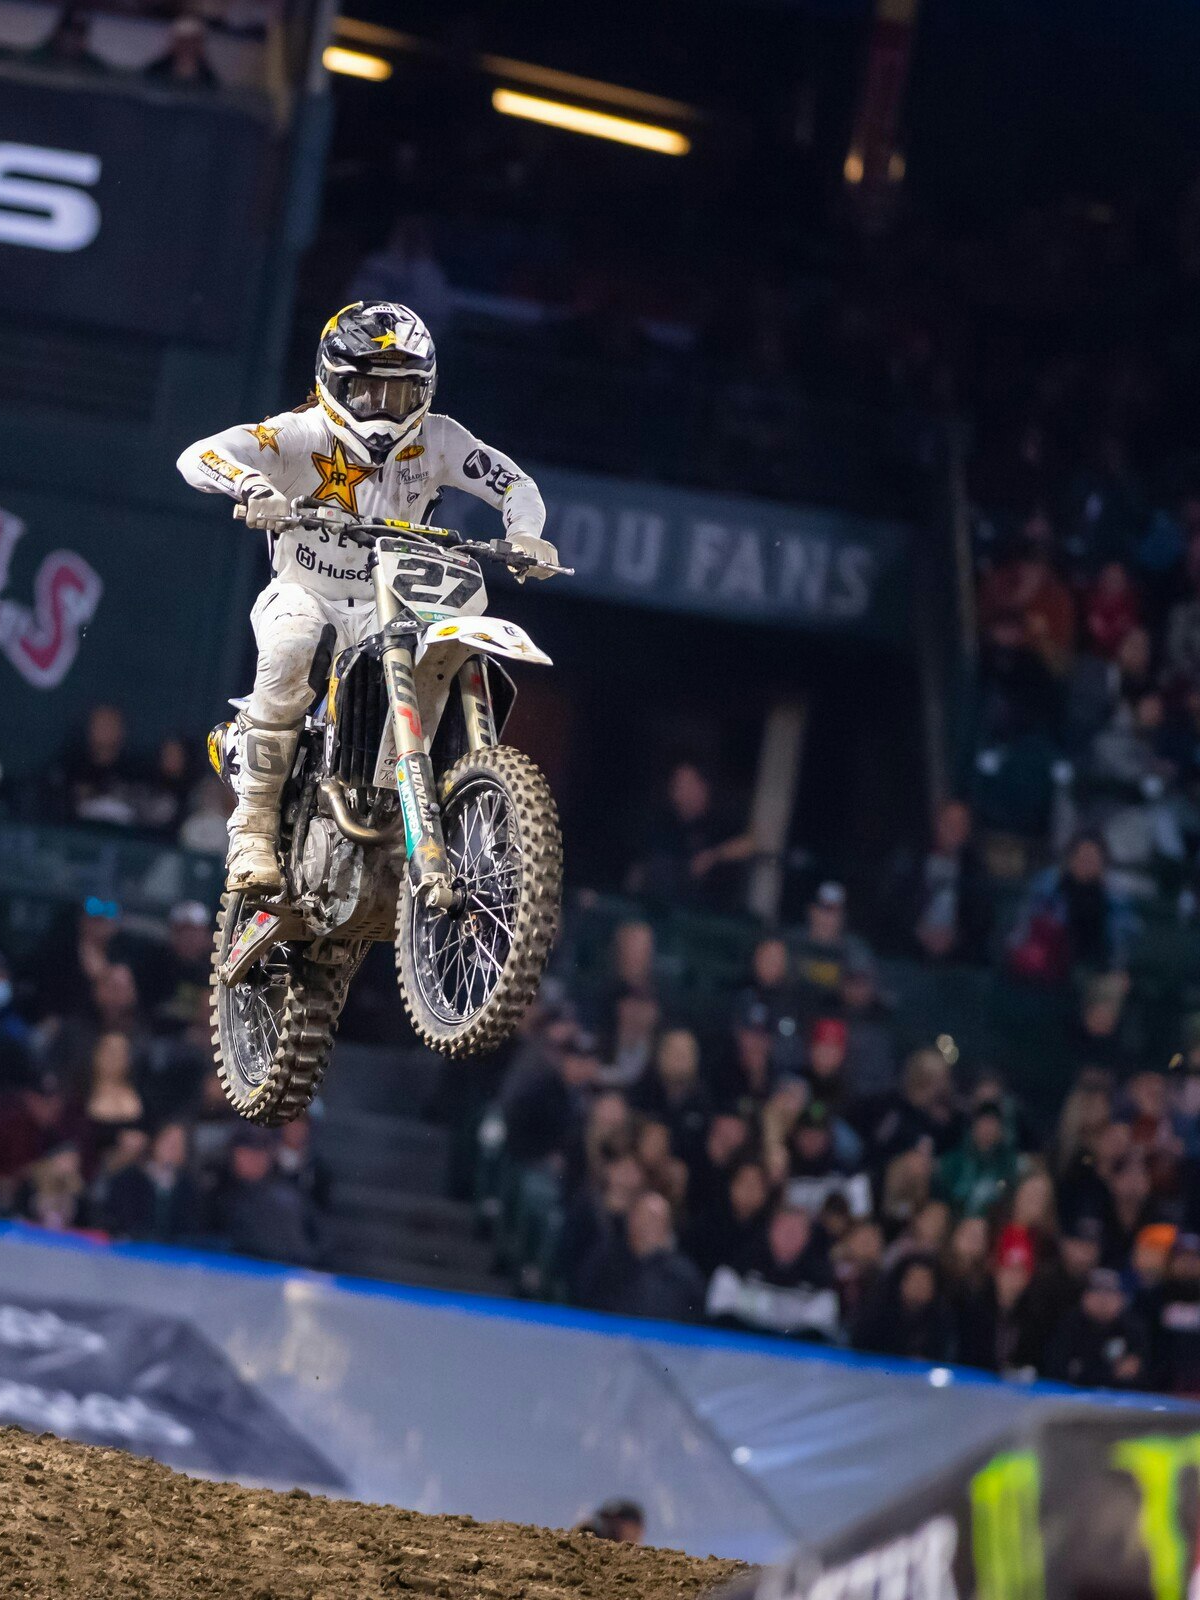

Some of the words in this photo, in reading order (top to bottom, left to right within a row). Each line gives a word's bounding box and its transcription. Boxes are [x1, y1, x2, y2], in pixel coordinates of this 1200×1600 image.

[317, 560, 372, 583] Husq
[392, 558, 483, 609] 27
[547, 501, 666, 586] OU
[688, 520, 874, 618] FANS
[400, 780, 421, 839] MOTOREX
[408, 759, 435, 834] DUNLOP
